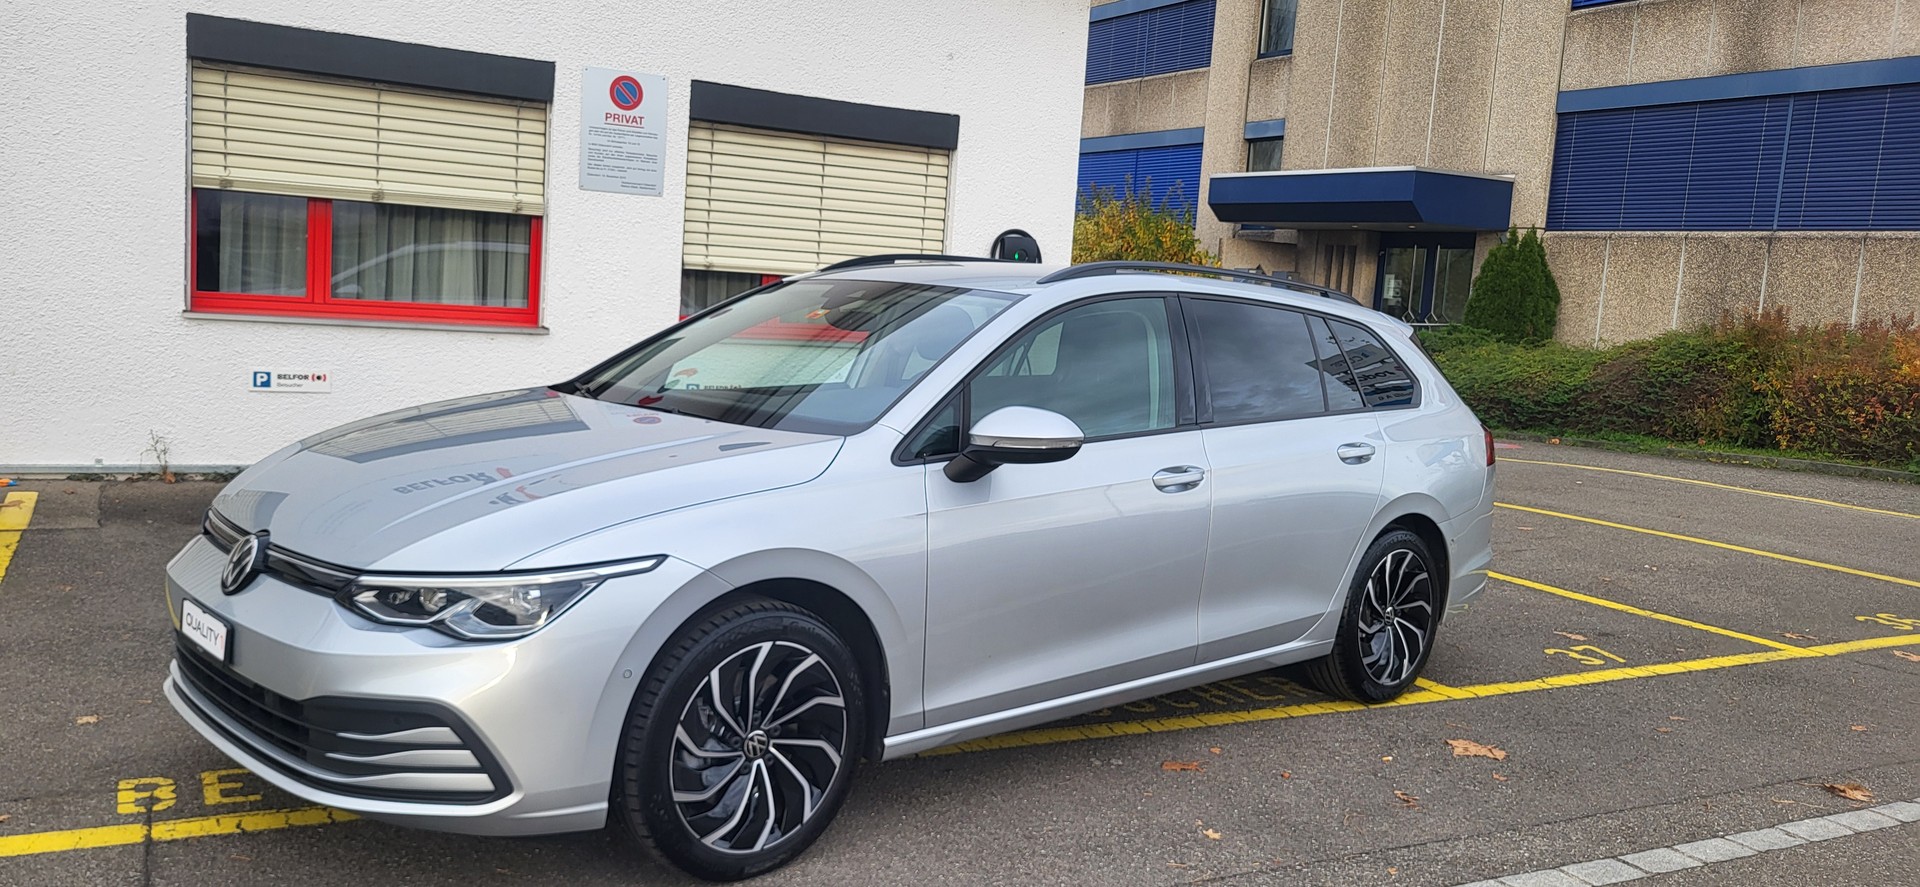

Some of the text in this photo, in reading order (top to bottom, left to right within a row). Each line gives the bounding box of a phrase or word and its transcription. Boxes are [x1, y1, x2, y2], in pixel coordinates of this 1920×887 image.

[605, 112, 644, 126] PRIVAT
[256, 372, 309, 387] P BELFOR
[1543, 645, 1627, 665] 37
